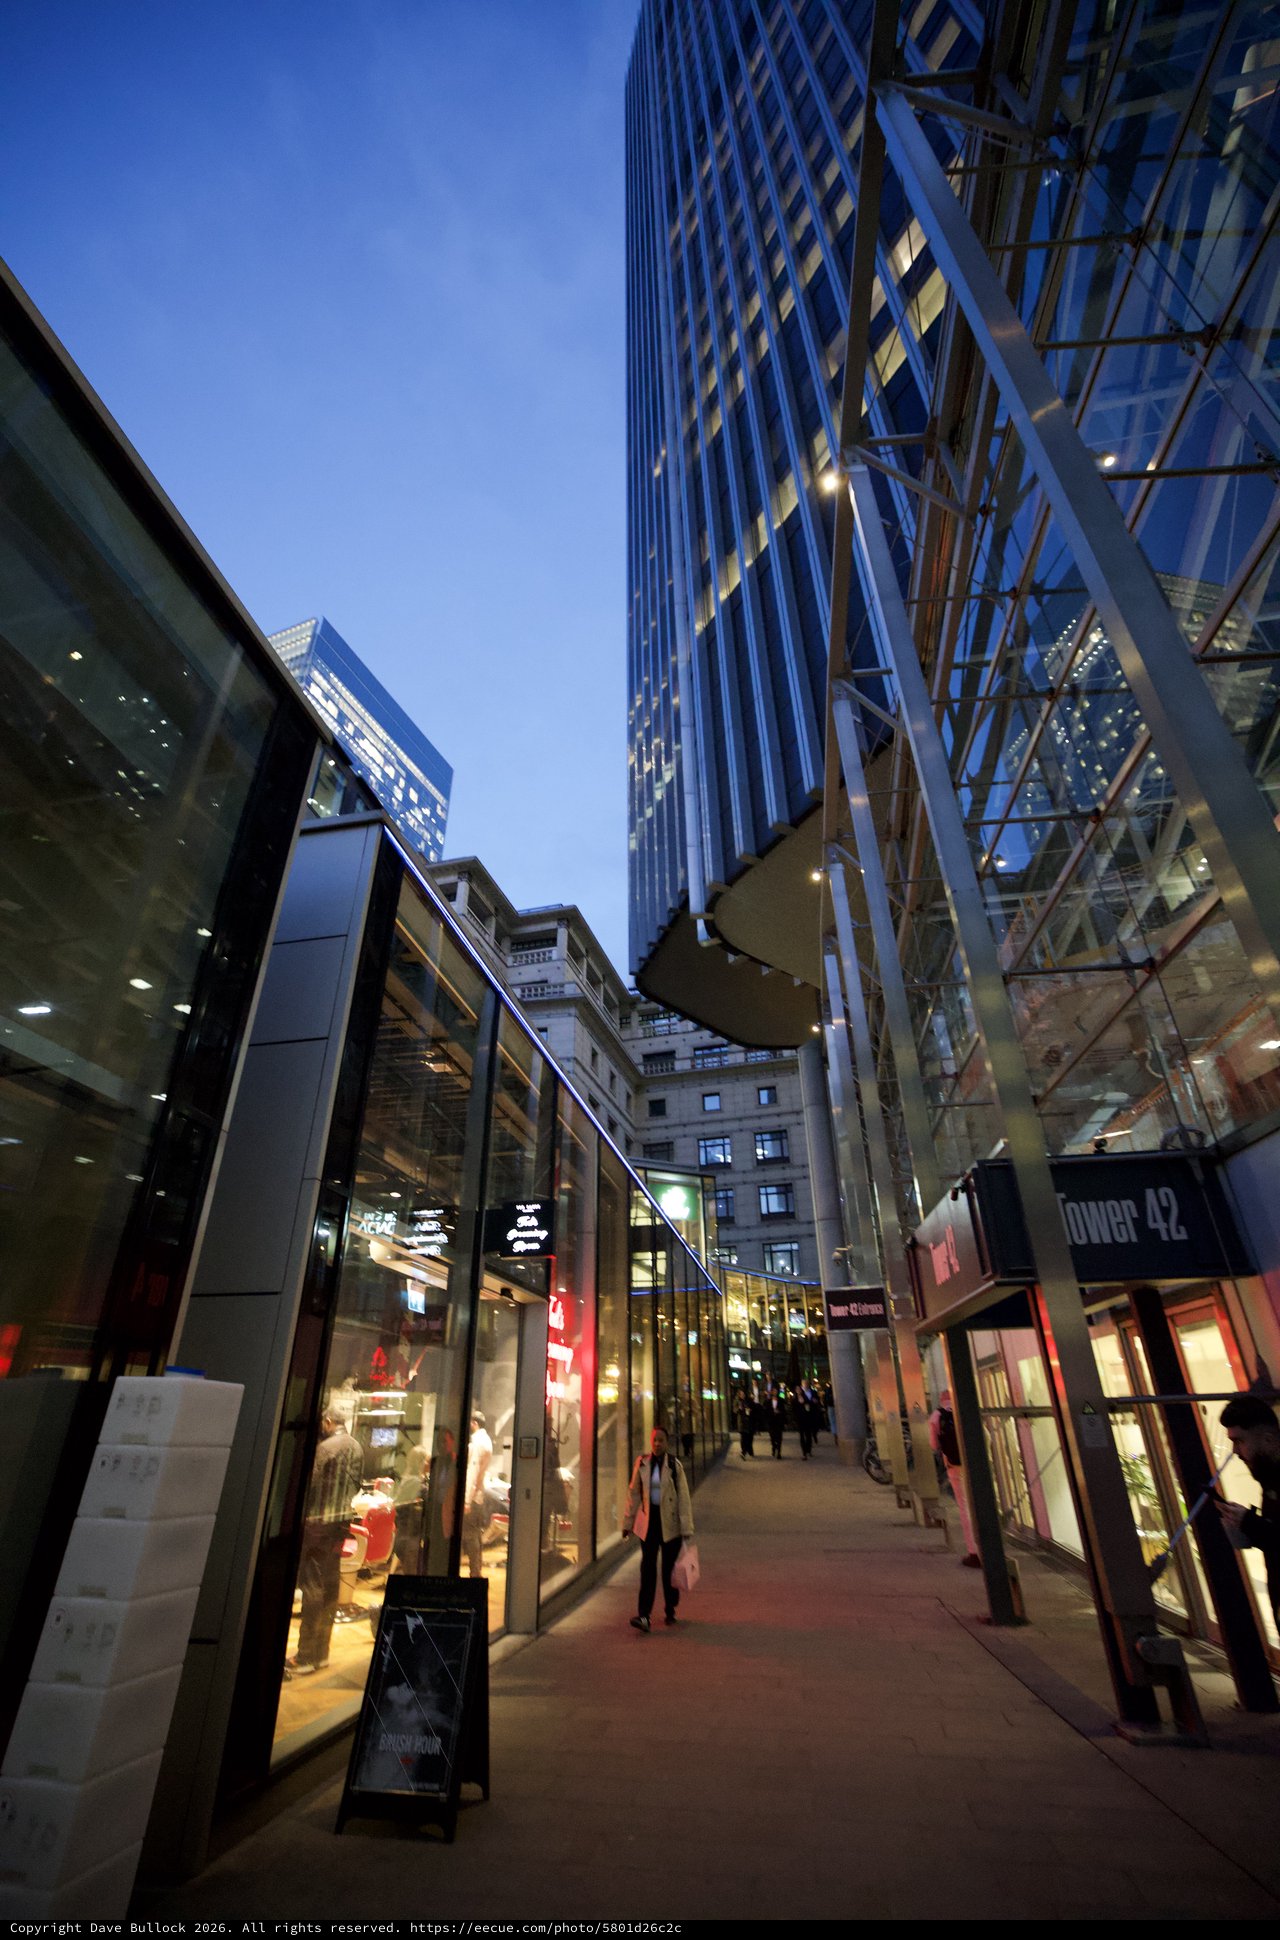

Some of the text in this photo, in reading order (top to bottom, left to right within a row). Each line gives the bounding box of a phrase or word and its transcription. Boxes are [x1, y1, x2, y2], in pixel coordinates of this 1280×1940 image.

[1145, 1187, 1188, 1242] 42
[928, 1224, 961, 1287] Tower 42
[829, 1303, 849, 1317] Tower
[379, 1733, 442, 1756] BRUSH HOUR
